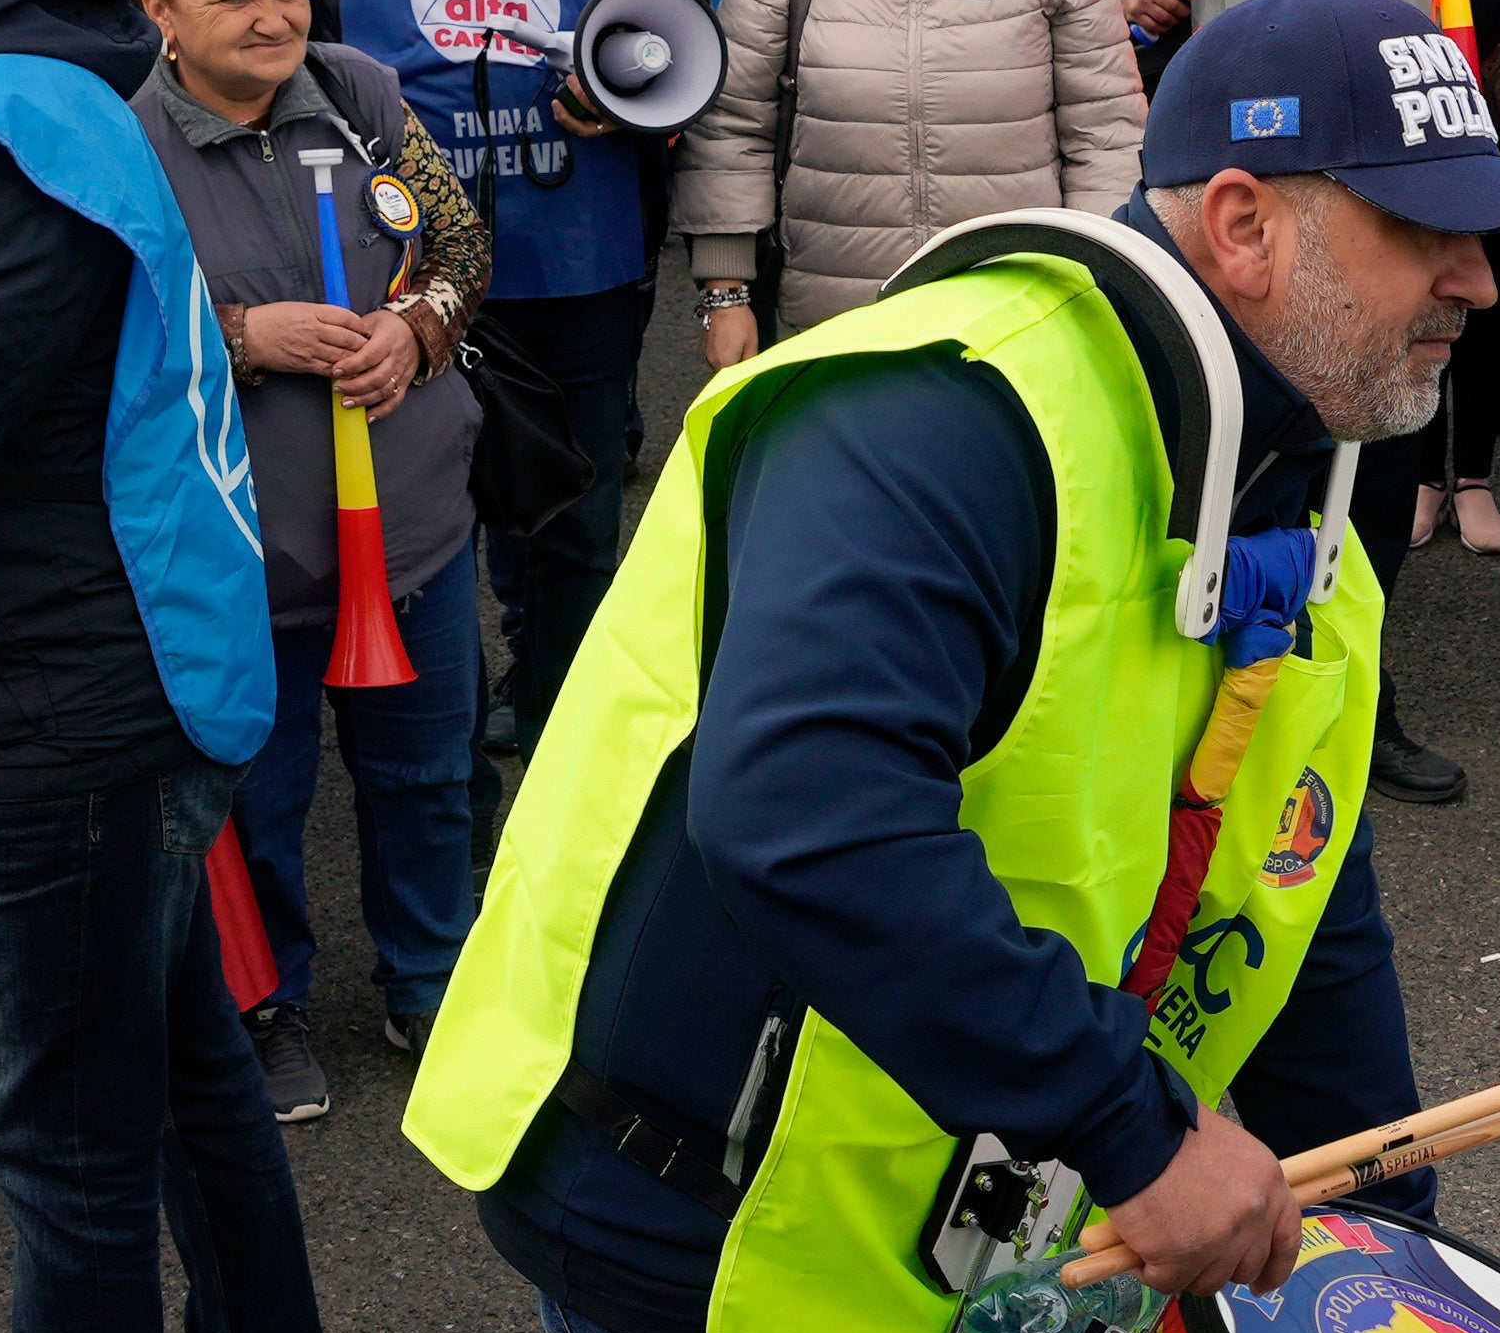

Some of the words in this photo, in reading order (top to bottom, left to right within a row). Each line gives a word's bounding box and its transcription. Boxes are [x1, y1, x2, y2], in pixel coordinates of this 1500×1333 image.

[1386, 1145, 1437, 1174] SPECIAL
[1324, 1279, 1395, 1325] POLICE
[1391, 1285, 1437, 1309] Trade
